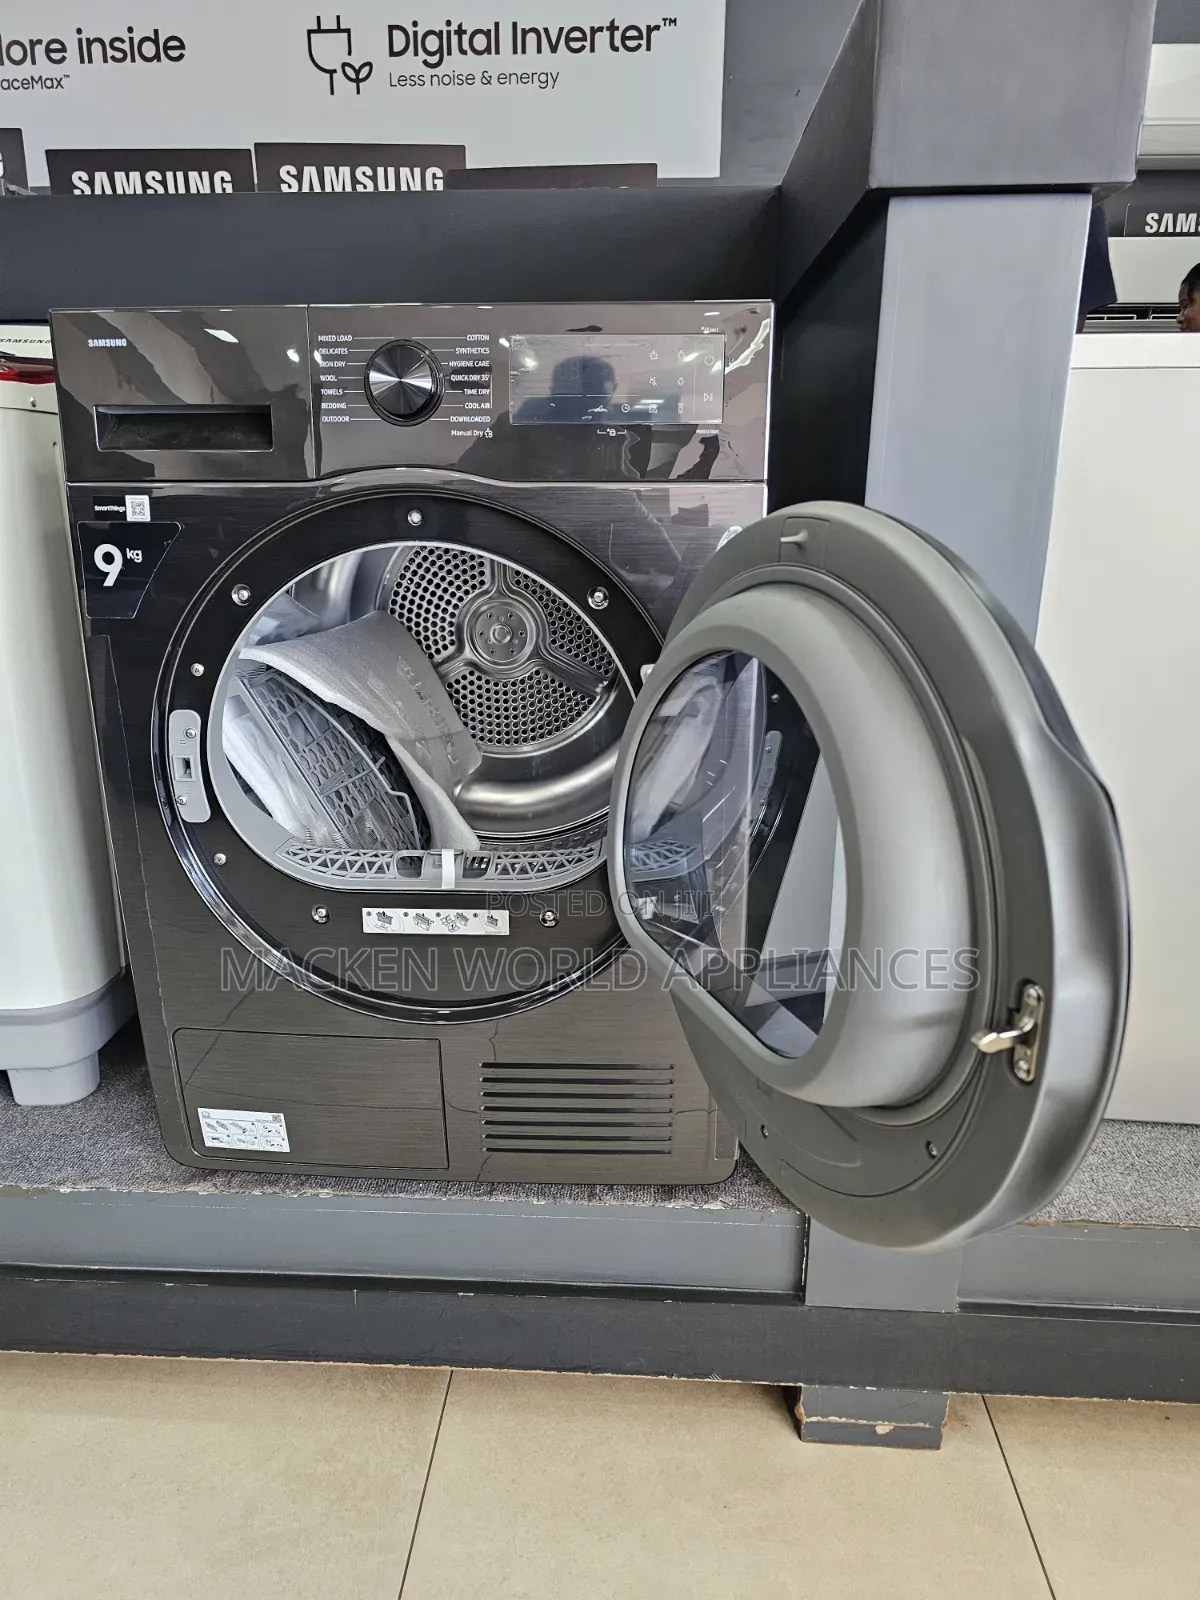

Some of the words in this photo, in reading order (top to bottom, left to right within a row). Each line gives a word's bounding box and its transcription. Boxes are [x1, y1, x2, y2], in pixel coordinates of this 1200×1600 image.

[0, 33, 68, 66] ore
[76, 26, 186, 64] inside
[387, 19, 501, 69] Digital
[389, 72, 426, 87] Less
[430, 70, 476, 87] noise
[480, 70, 493, 86] &
[496, 70, 560, 90] energy
[71, 170, 233, 195] SAMSUNG
[279, 165, 444, 192] SAMSUNG
[1144, 212, 1200, 234] SAM
[317, 334, 336, 342] MIXED
[336, 334, 353, 342] LOAD
[87, 338, 127, 348] SAMSUNG
[318, 347, 349, 355] DELICATES
[319, 360, 333, 368] IRON
[333, 360, 346, 368] DRY
[319, 374, 338, 382] WOOL
[450, 374, 469, 382] QUICK
[320, 388, 344, 396] TOWELS
[449, 415, 491, 423] DOWNLOADED
[472, 429, 484, 437] Dry
[93, 543, 123, 587] 9
[126, 547, 143, 563] kg
